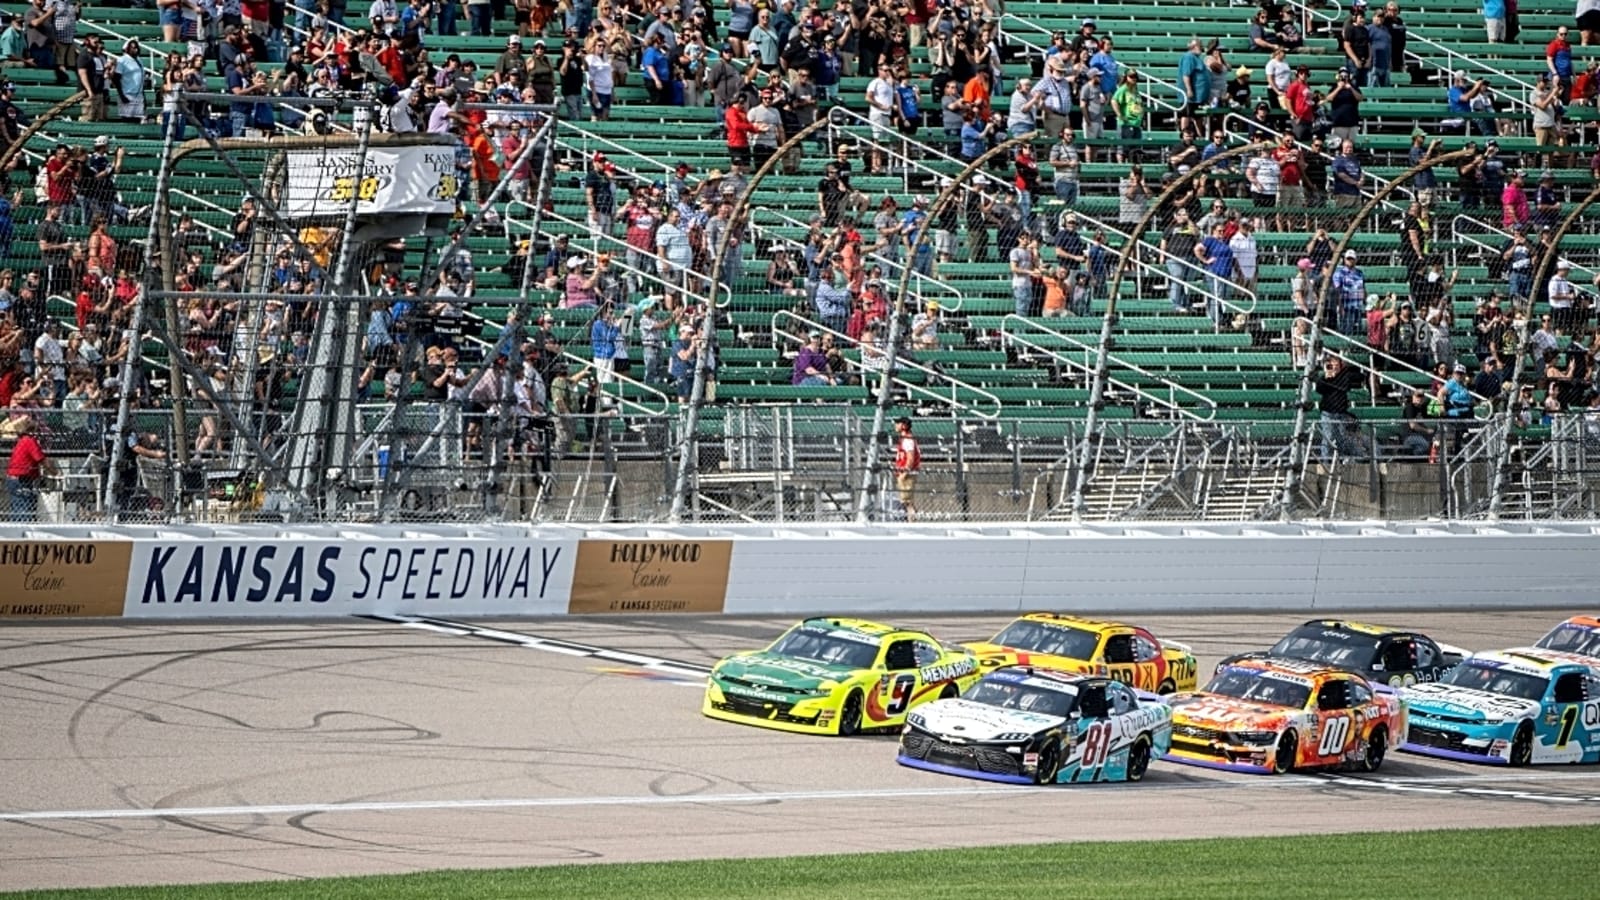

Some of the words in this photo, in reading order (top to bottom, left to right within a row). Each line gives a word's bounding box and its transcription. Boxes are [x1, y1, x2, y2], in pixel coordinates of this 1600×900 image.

[317, 156, 375, 167] KANSS
[325, 165, 393, 176] LOTERY
[0, 544, 97, 565] HOLLYWOOD
[610, 543, 702, 563] HOLLYWOOD
[23, 563, 65, 591] Casino
[142, 546, 341, 604] KANSAS
[352, 547, 561, 600] SPEEDWAY
[632, 563, 671, 589] Casino
[11, 604, 43, 615] KANSAS
[44, 604, 80, 615] SPEEDWAY
[621, 600, 651, 610] KANSAS
[652, 600, 687, 610] SPEEDWAY
[922, 660, 973, 684] MENARDS
[885, 673, 916, 717] 9
[1318, 716, 1349, 756] 00
[1556, 705, 1578, 749] 1
[1081, 720, 1113, 767] 81
